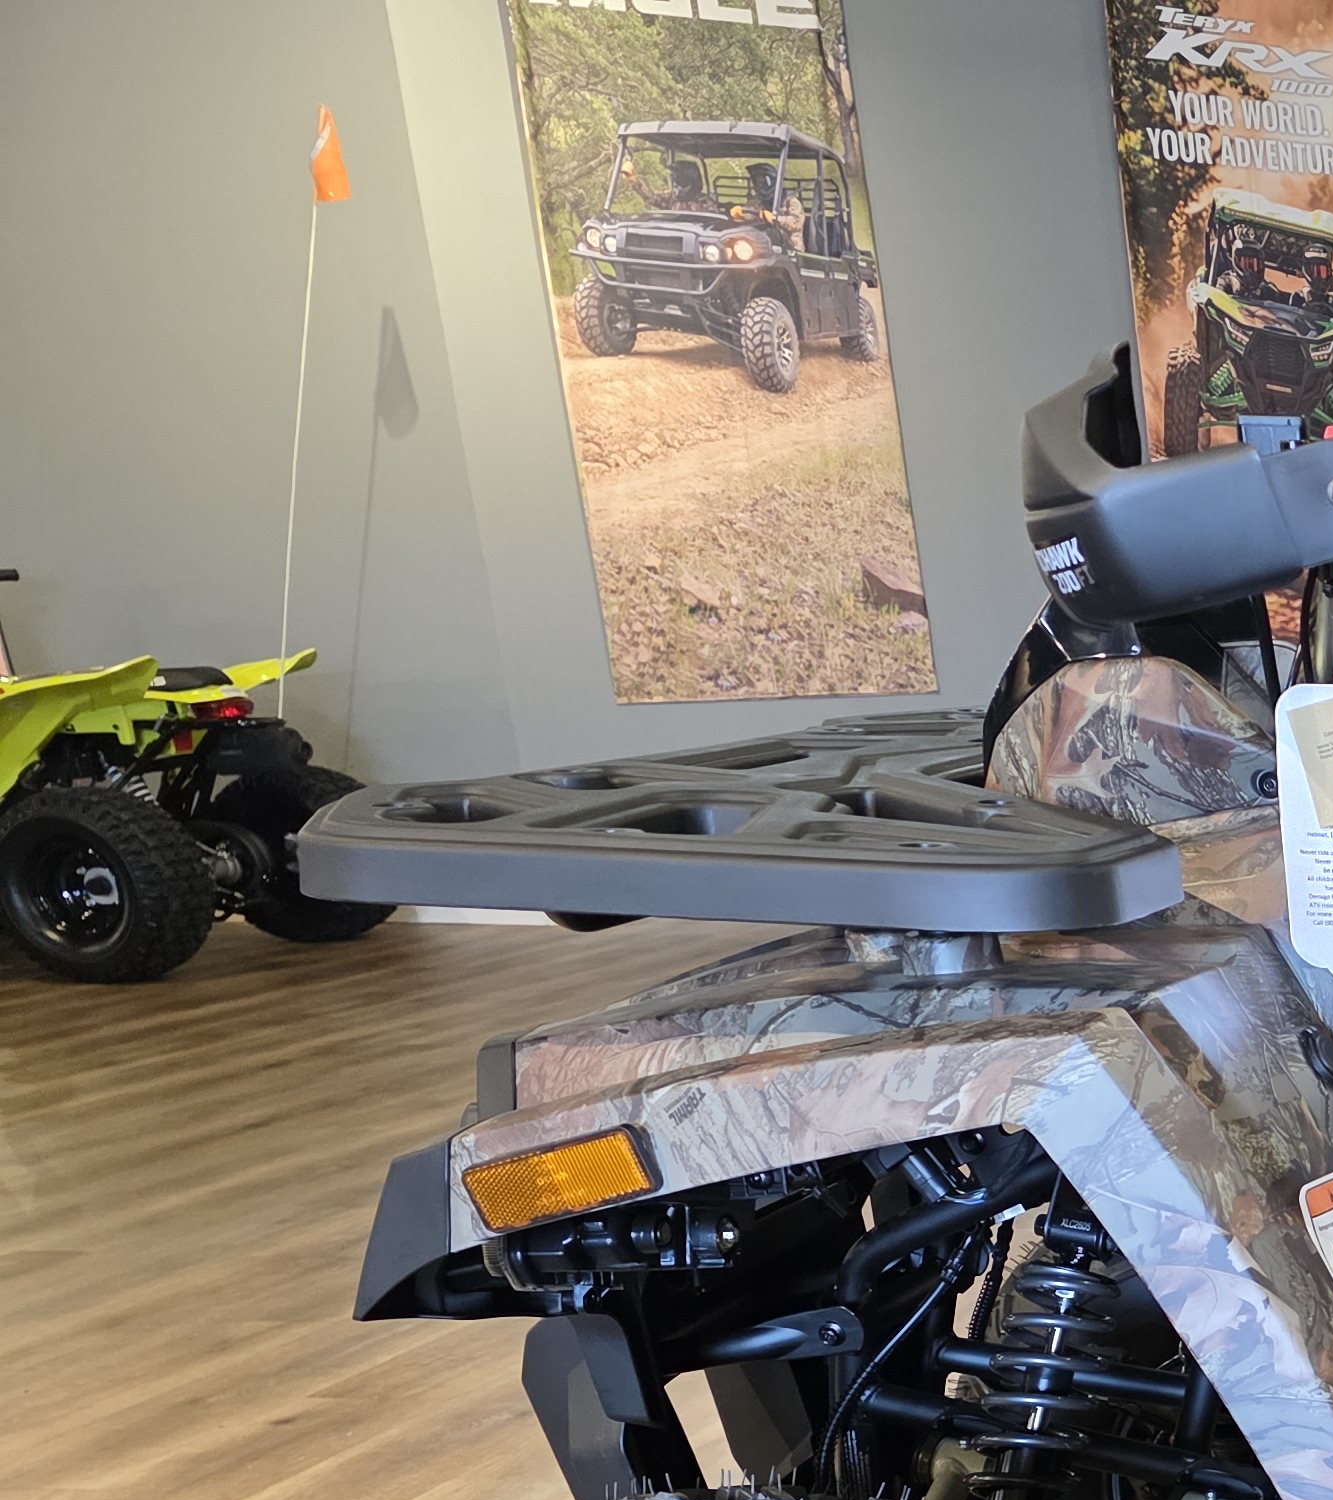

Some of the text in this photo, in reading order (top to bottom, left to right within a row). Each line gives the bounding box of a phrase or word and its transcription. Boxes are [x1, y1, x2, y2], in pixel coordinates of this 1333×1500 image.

[1155, 5, 1254, 34] TERYX
[1145, 27, 1333, 79] KRX
[1168, 90, 1329, 137] YOUR WORLD.
[1146, 127, 1212, 165] YOUR
